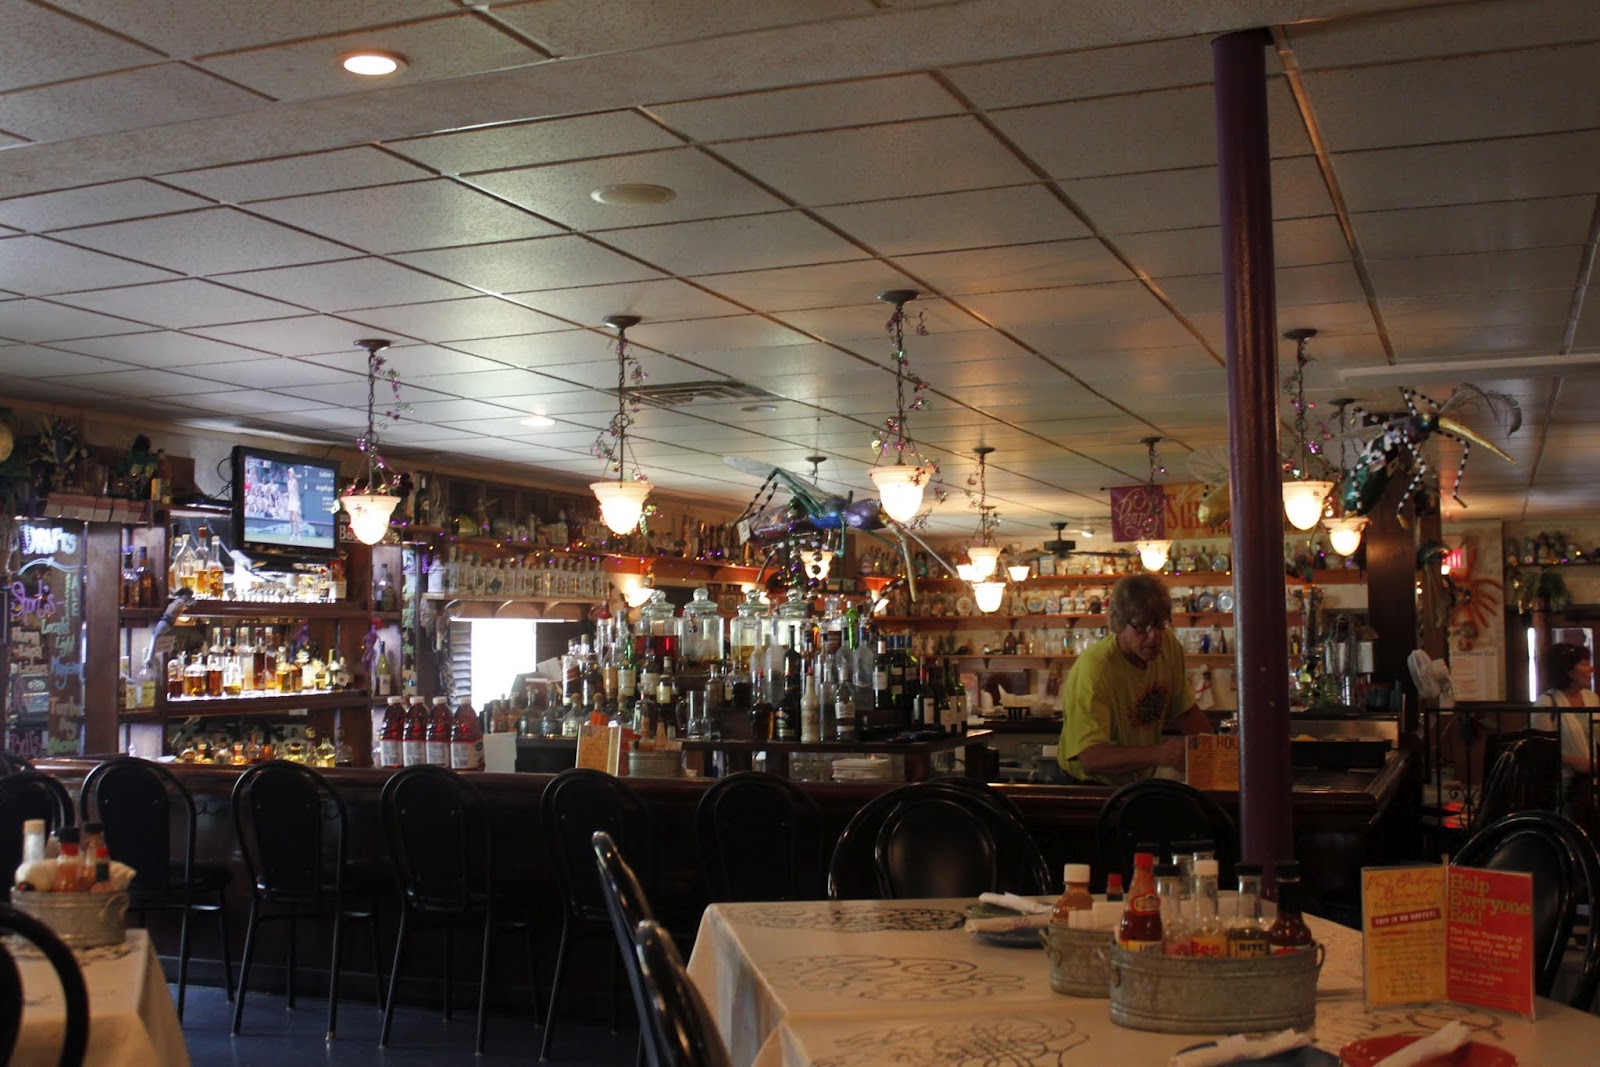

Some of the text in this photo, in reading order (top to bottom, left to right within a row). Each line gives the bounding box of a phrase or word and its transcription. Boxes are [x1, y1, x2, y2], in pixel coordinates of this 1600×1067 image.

[1450, 873, 1490, 896] Help
[1450, 890, 1530, 916] Everyone
[1450, 911, 1482, 926] Eat!
